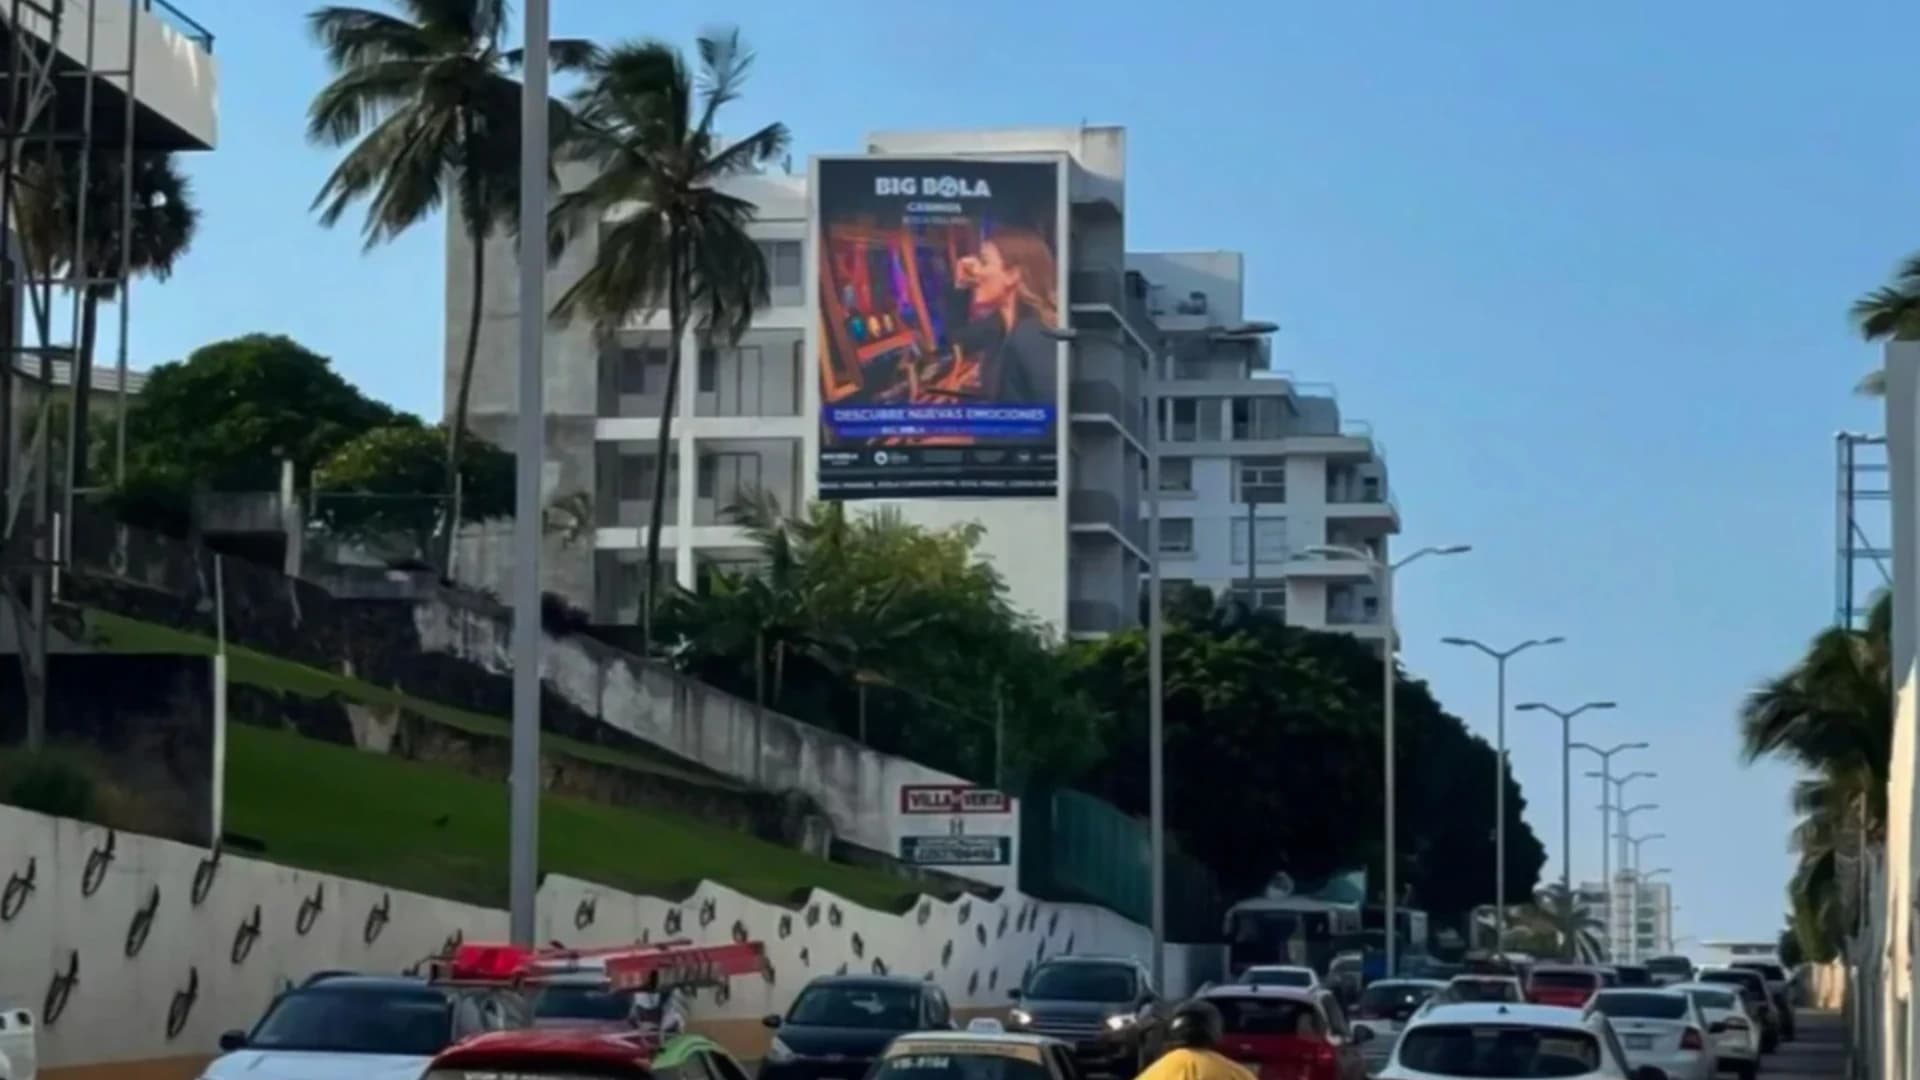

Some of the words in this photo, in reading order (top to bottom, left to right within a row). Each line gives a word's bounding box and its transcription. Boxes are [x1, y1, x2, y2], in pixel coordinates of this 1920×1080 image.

[875, 176, 917, 196] BIG
[922, 175, 992, 198] BOLA
[834, 409, 905, 422] DESCUBRE
[908, 408, 963, 420] NUEVAS
[966, 408, 1046, 420] EMOCIONES
[910, 793, 952, 808] VILLA
